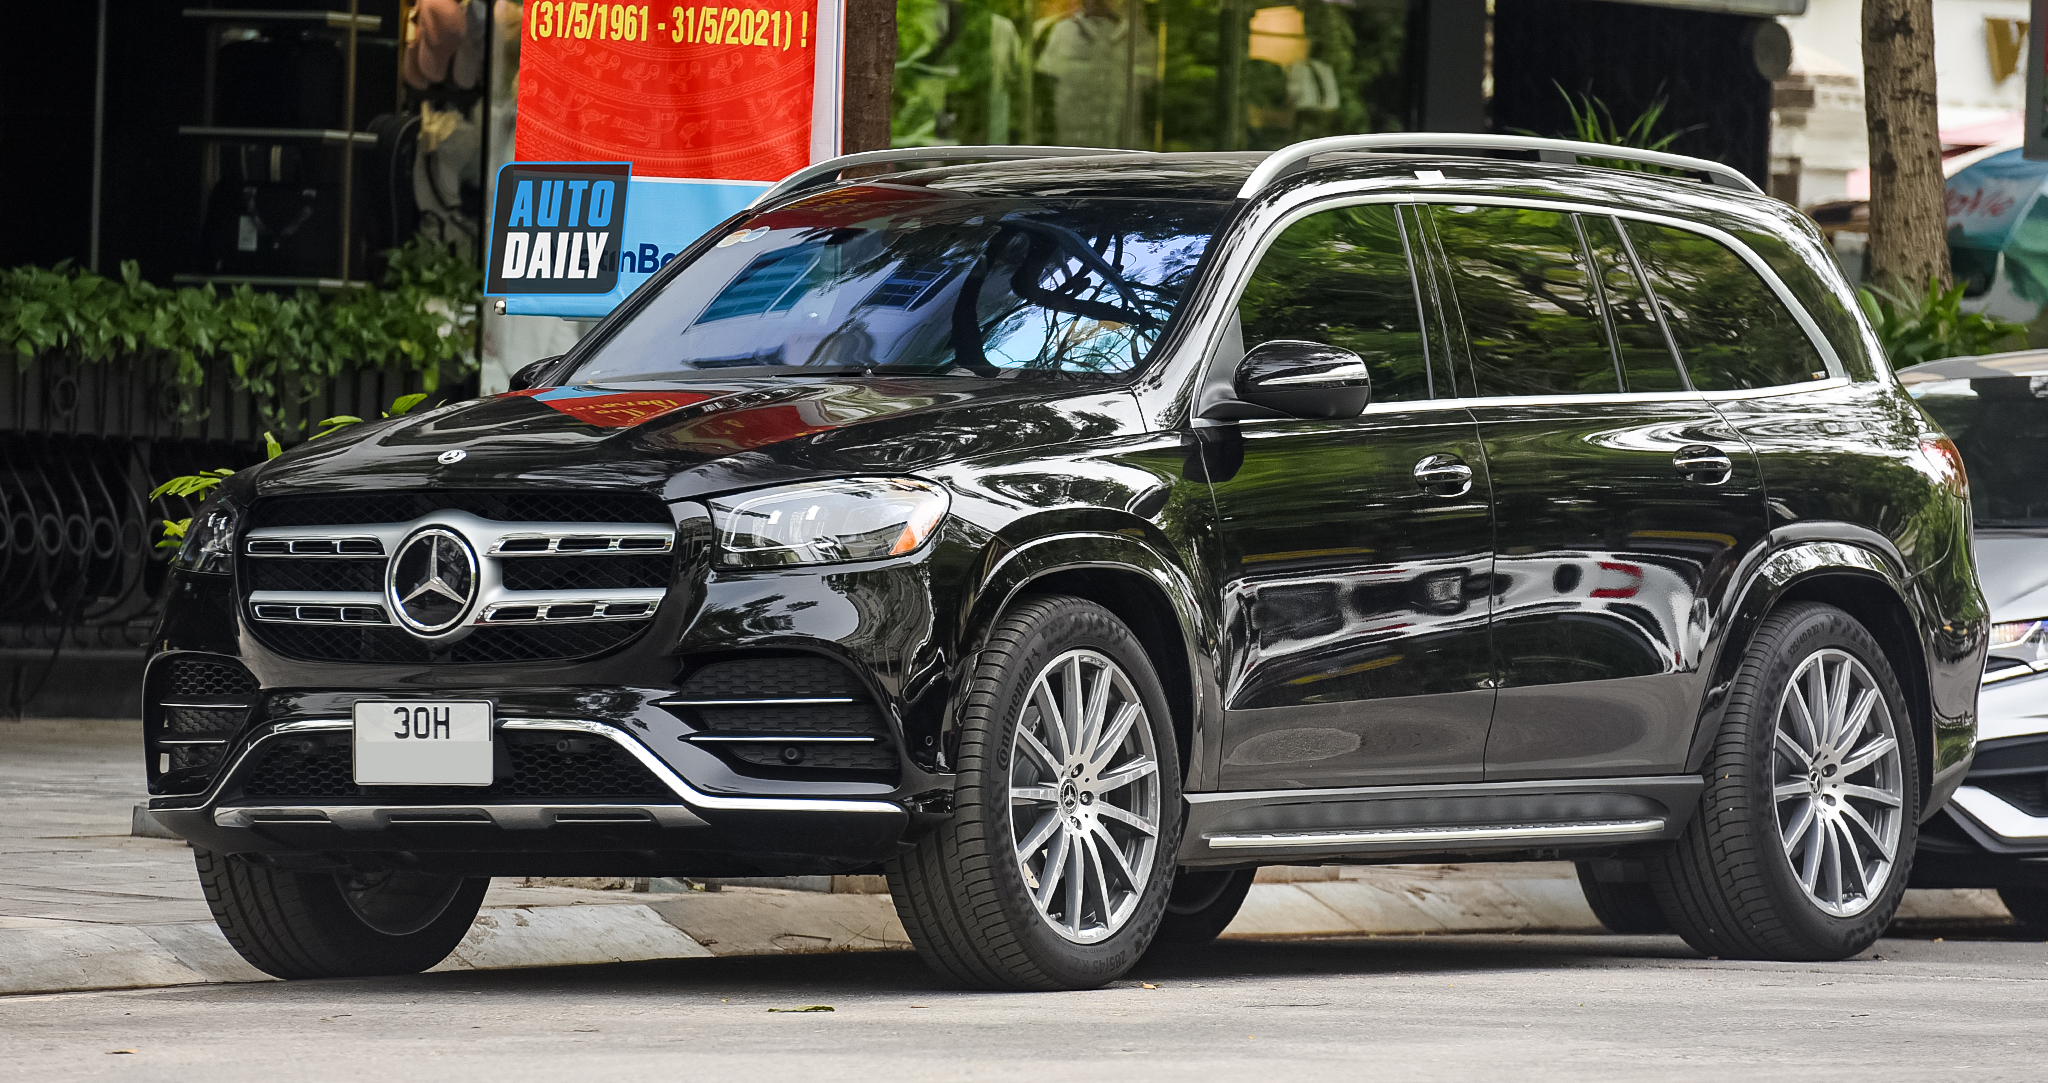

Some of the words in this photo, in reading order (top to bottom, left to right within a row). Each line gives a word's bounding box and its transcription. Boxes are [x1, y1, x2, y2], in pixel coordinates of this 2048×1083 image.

[530, 1, 649, 41] (31/5/1961
[657, 23, 666, 31] -
[671, 7, 792, 51] 31/5/2021)
[393, 706, 450, 739] 30H
[996, 656, 1036, 772] Continental
